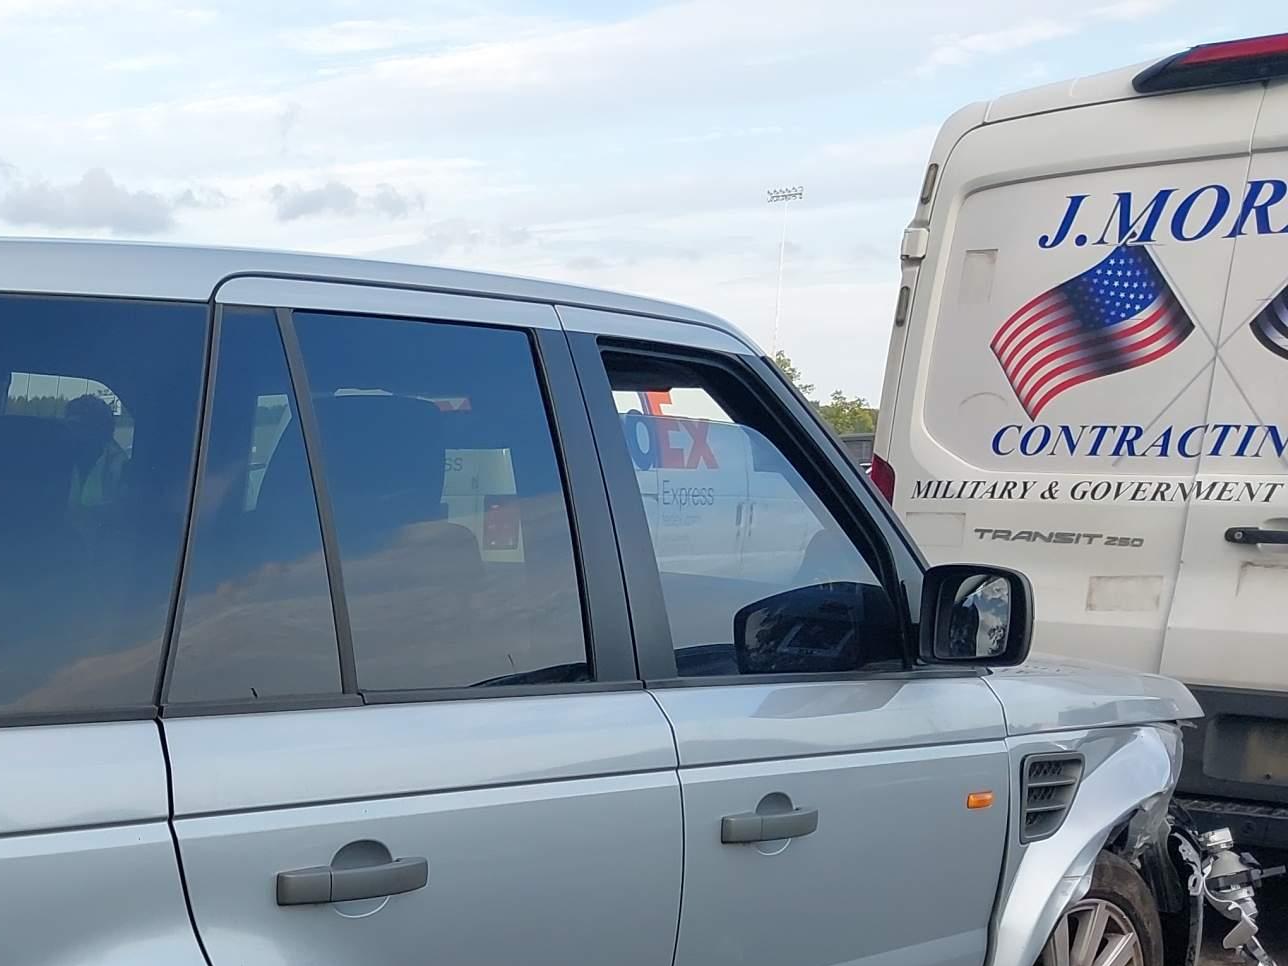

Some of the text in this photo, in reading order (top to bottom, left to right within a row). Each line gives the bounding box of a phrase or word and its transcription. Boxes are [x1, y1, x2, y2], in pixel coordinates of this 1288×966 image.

[1038, 178, 1288, 249] J.MOR
[662, 480, 714, 512] Express
[911, 480, 1285, 503] MILITARY & GOVERNMENT
[974, 528, 1144, 548] TRANSIT 250
